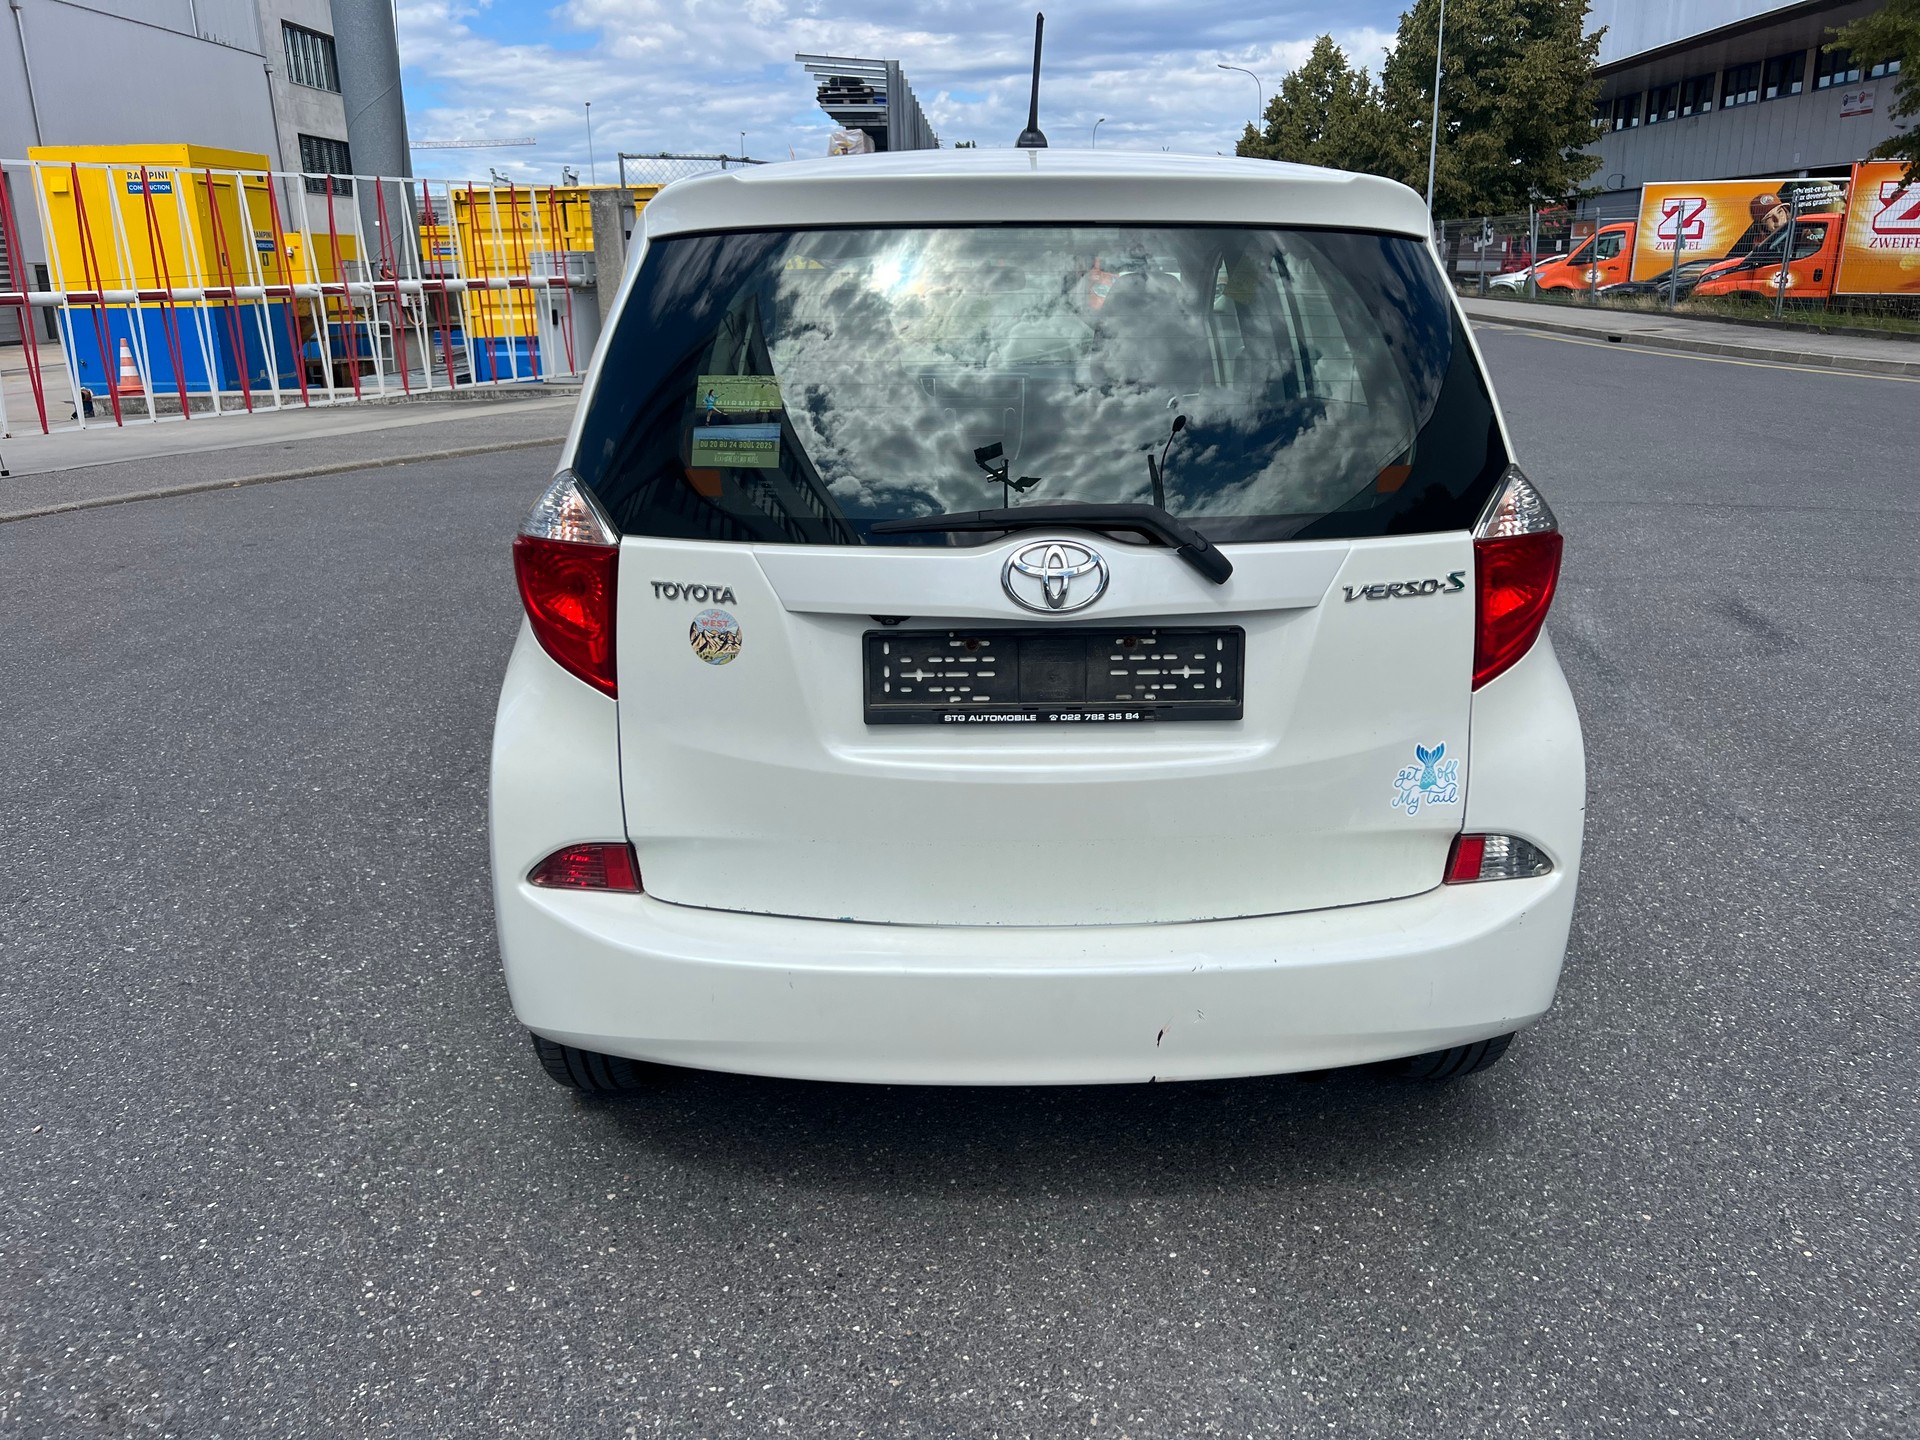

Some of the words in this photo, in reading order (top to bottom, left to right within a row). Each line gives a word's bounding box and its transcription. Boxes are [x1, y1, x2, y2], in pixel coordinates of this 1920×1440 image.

[127, 171, 168, 180] RAPINI
[1869, 237, 1920, 249] ZWEIFE
[650, 581, 738, 605] TOYOTA
[1342, 570, 1466, 602] VERSO-S
[701, 619, 730, 628] WEST
[944, 714, 965, 722] STG
[968, 714, 1037, 722] AUTOMOBILE
[1060, 713, 1081, 721] 022
[1084, 713, 1105, 721] 782
[1108, 712, 1122, 720] 35
[1125, 712, 1140, 720] 84
[1394, 766, 1422, 788] get
[1437, 760, 1458, 783] off
[1392, 790, 1420, 815] My
[1421, 787, 1458, 804] tail
